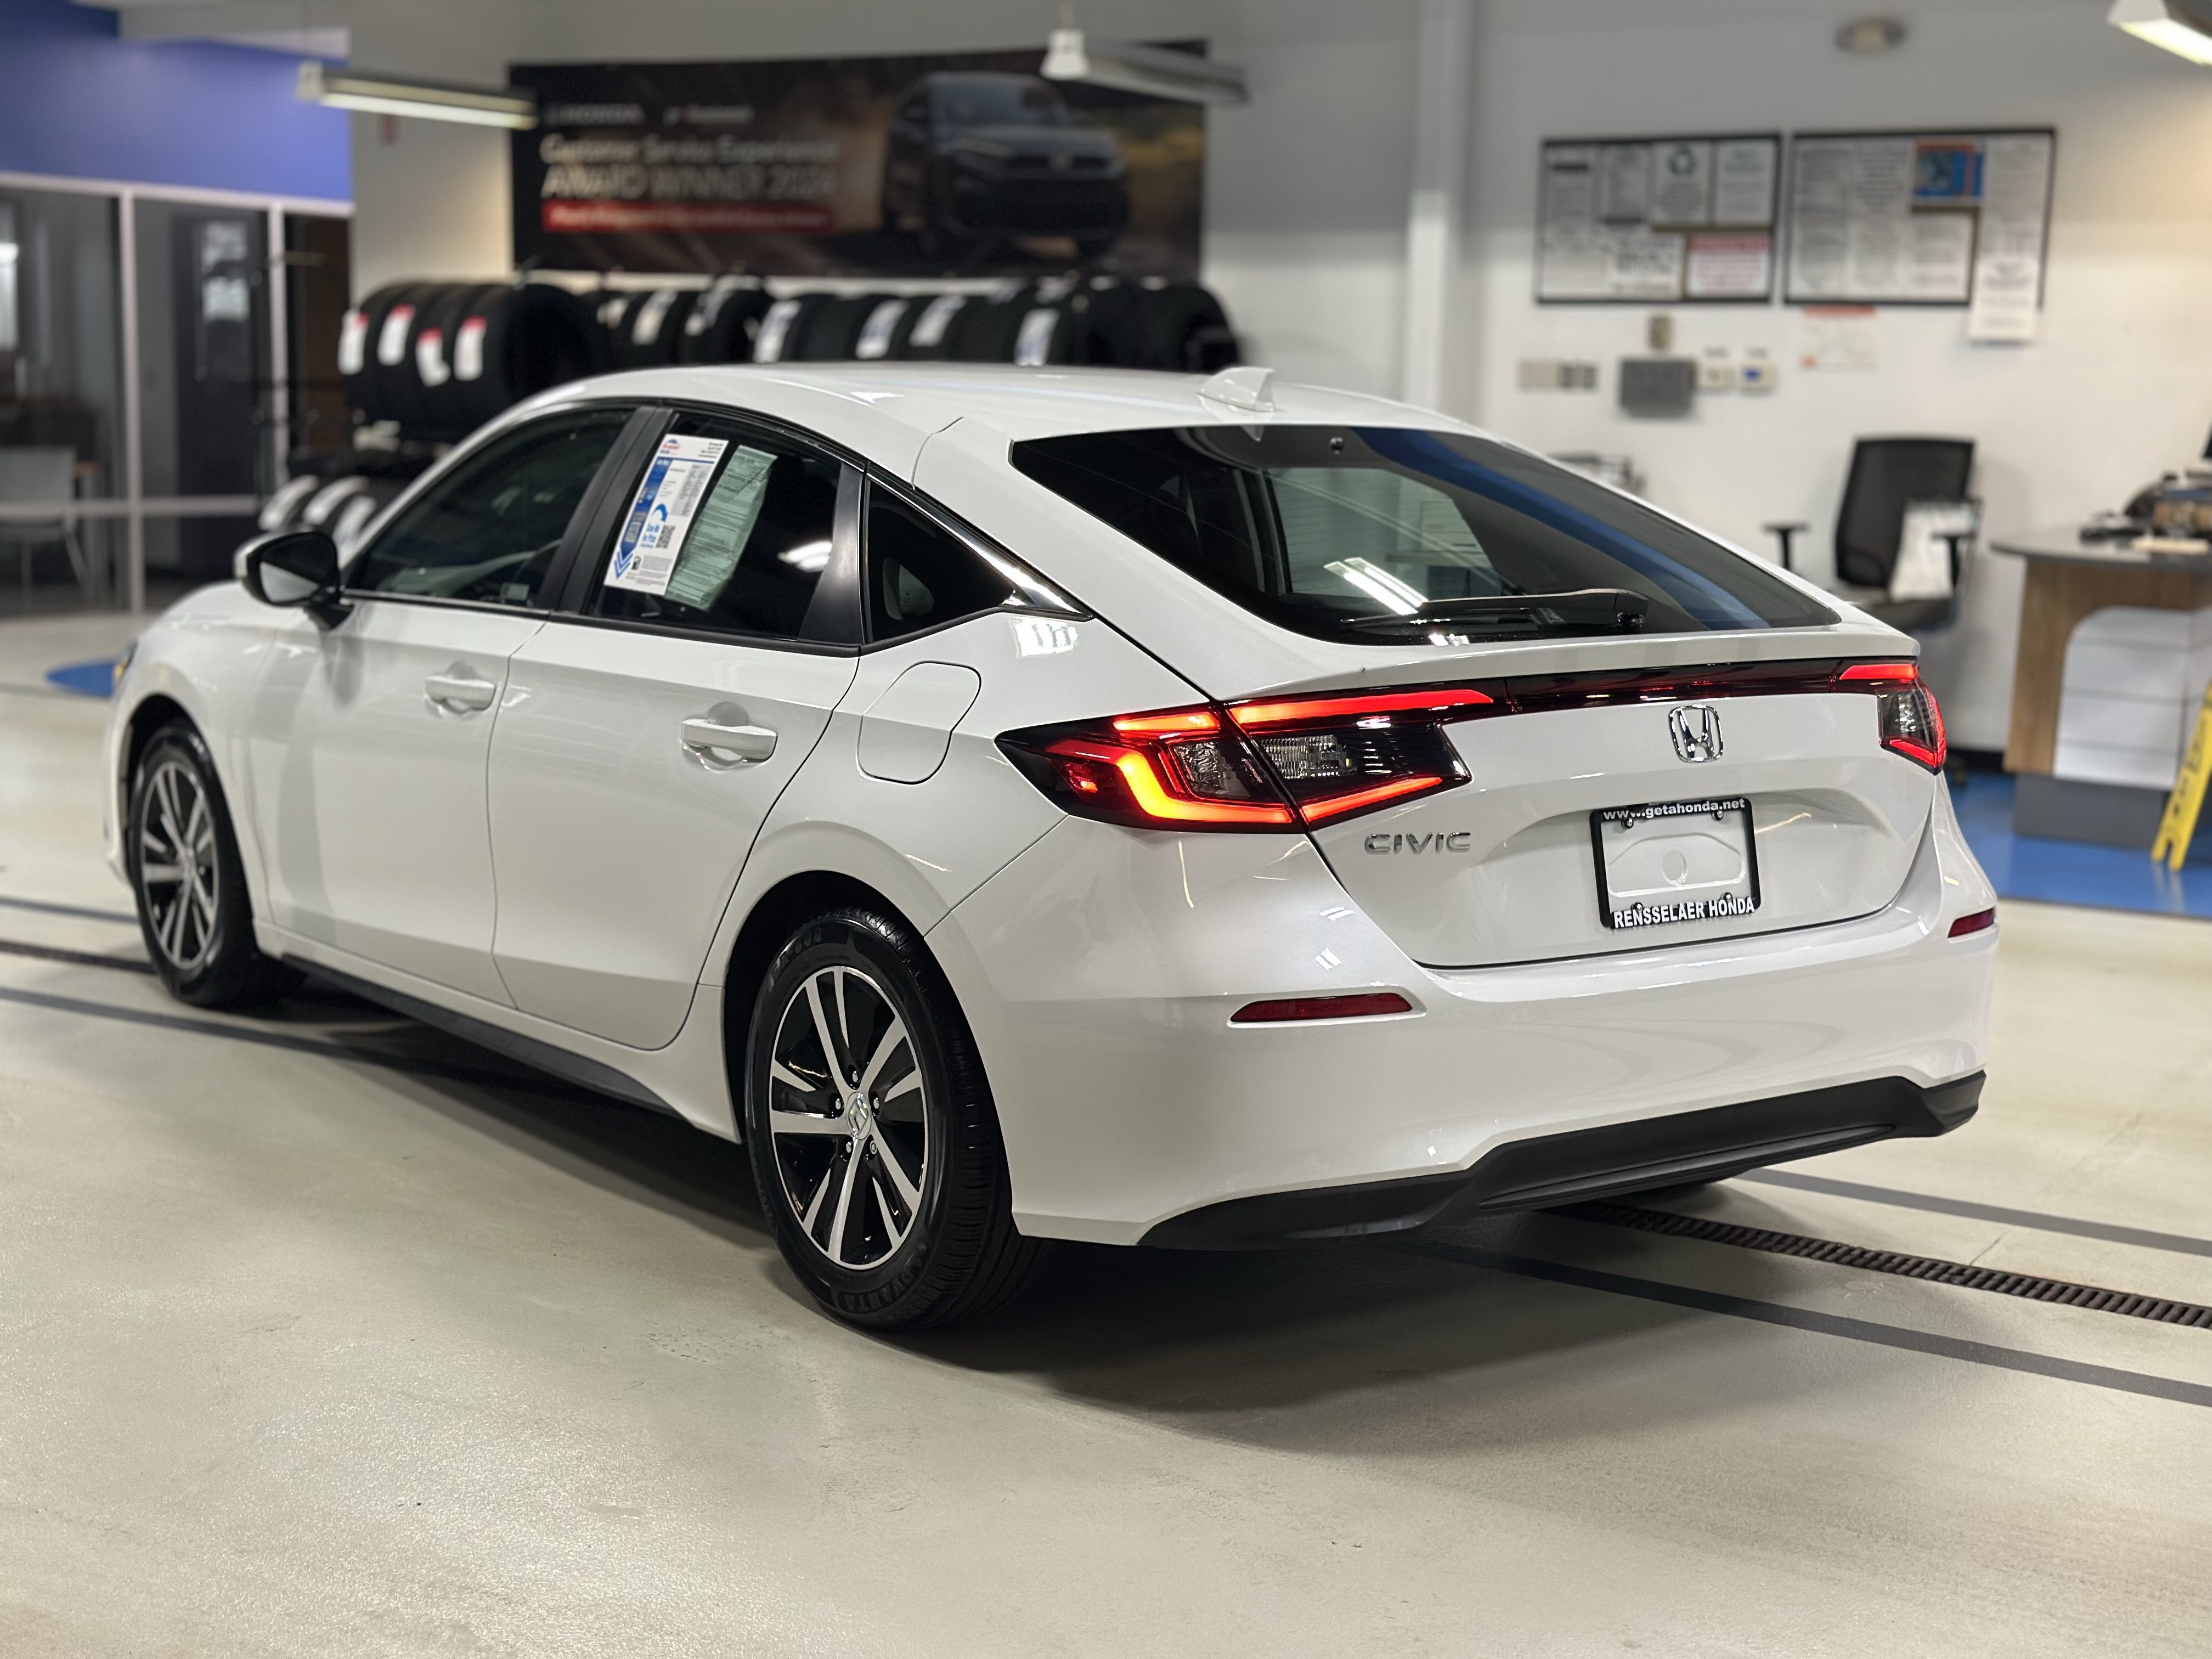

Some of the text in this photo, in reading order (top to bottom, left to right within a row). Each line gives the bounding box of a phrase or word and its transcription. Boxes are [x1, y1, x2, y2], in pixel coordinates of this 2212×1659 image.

[1364, 832, 1471, 854] CIVIC
[1613, 896, 1755, 928] RENSSELAER HONDA
